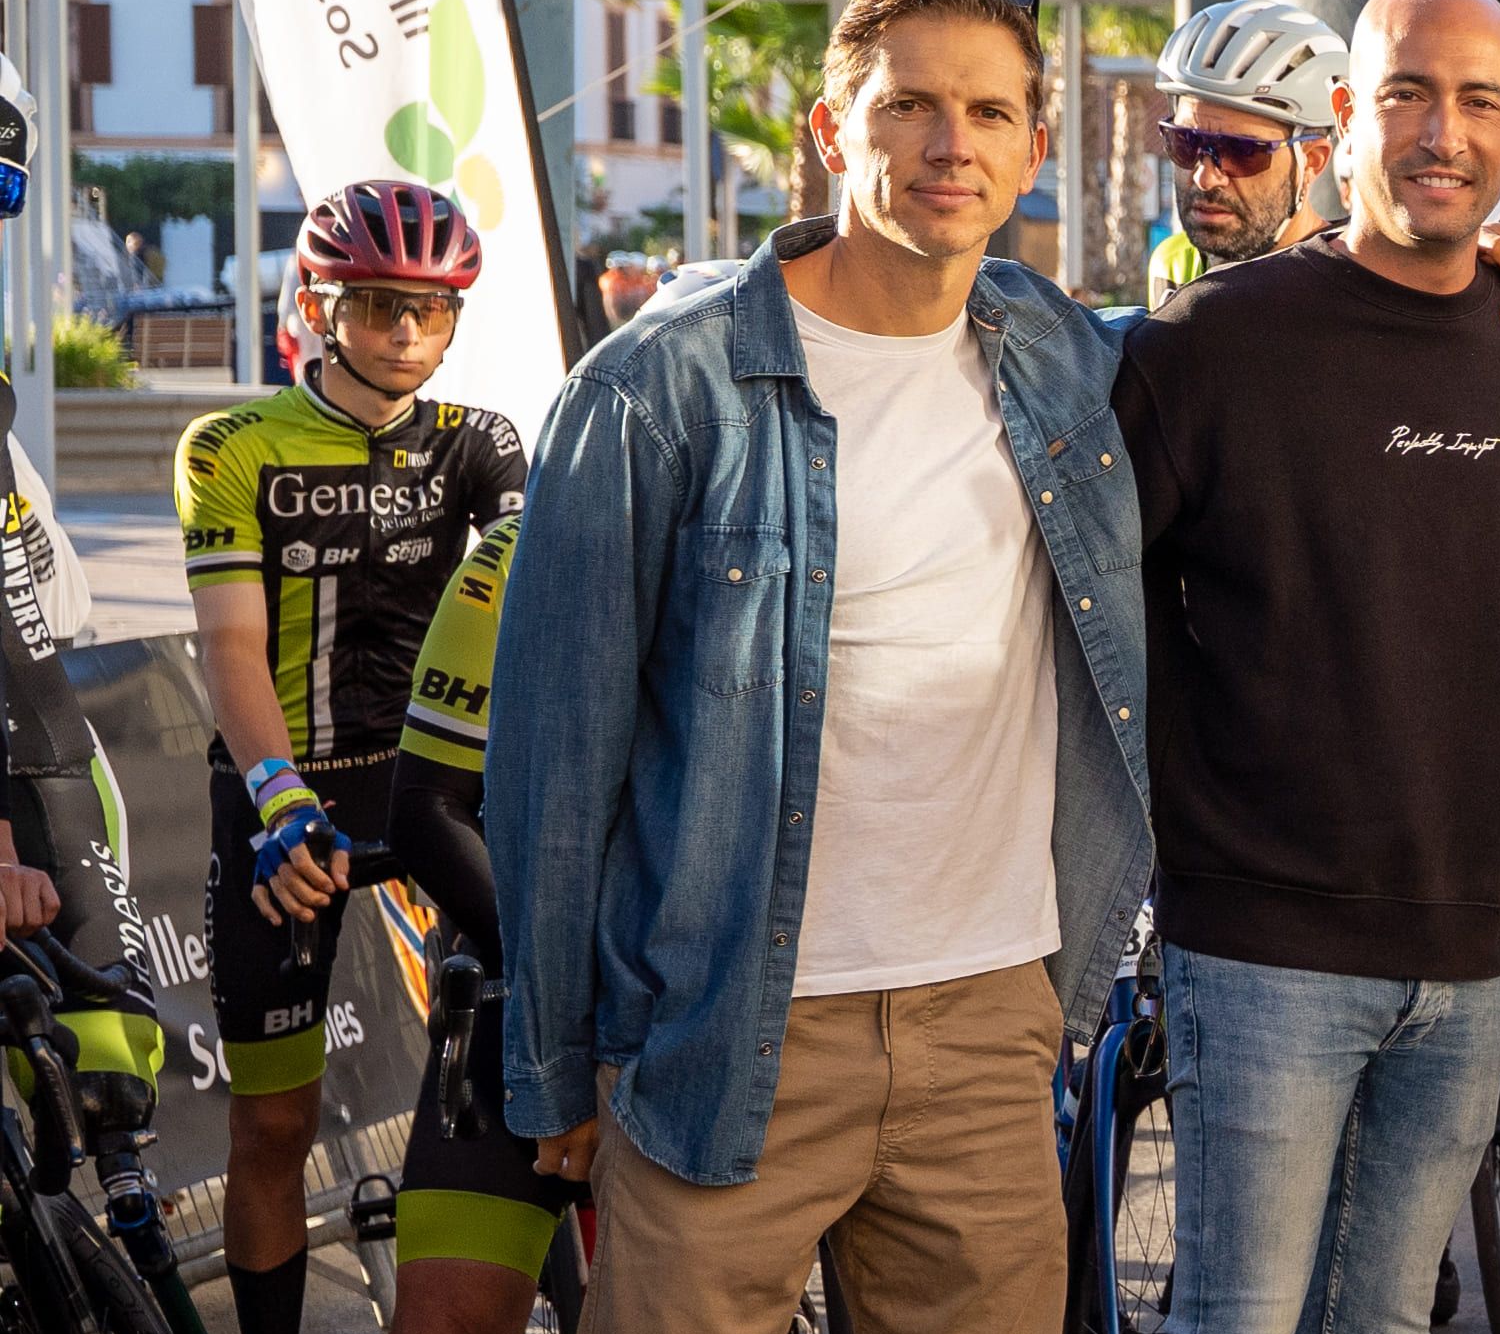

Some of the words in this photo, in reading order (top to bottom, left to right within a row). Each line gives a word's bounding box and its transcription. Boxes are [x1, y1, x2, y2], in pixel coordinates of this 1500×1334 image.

[268, 471, 445, 518] Genesis
[185, 527, 236, 550] BH
[322, 547, 361, 565] BH
[419, 667, 491, 715] BH
[264, 999, 313, 1035] BH
